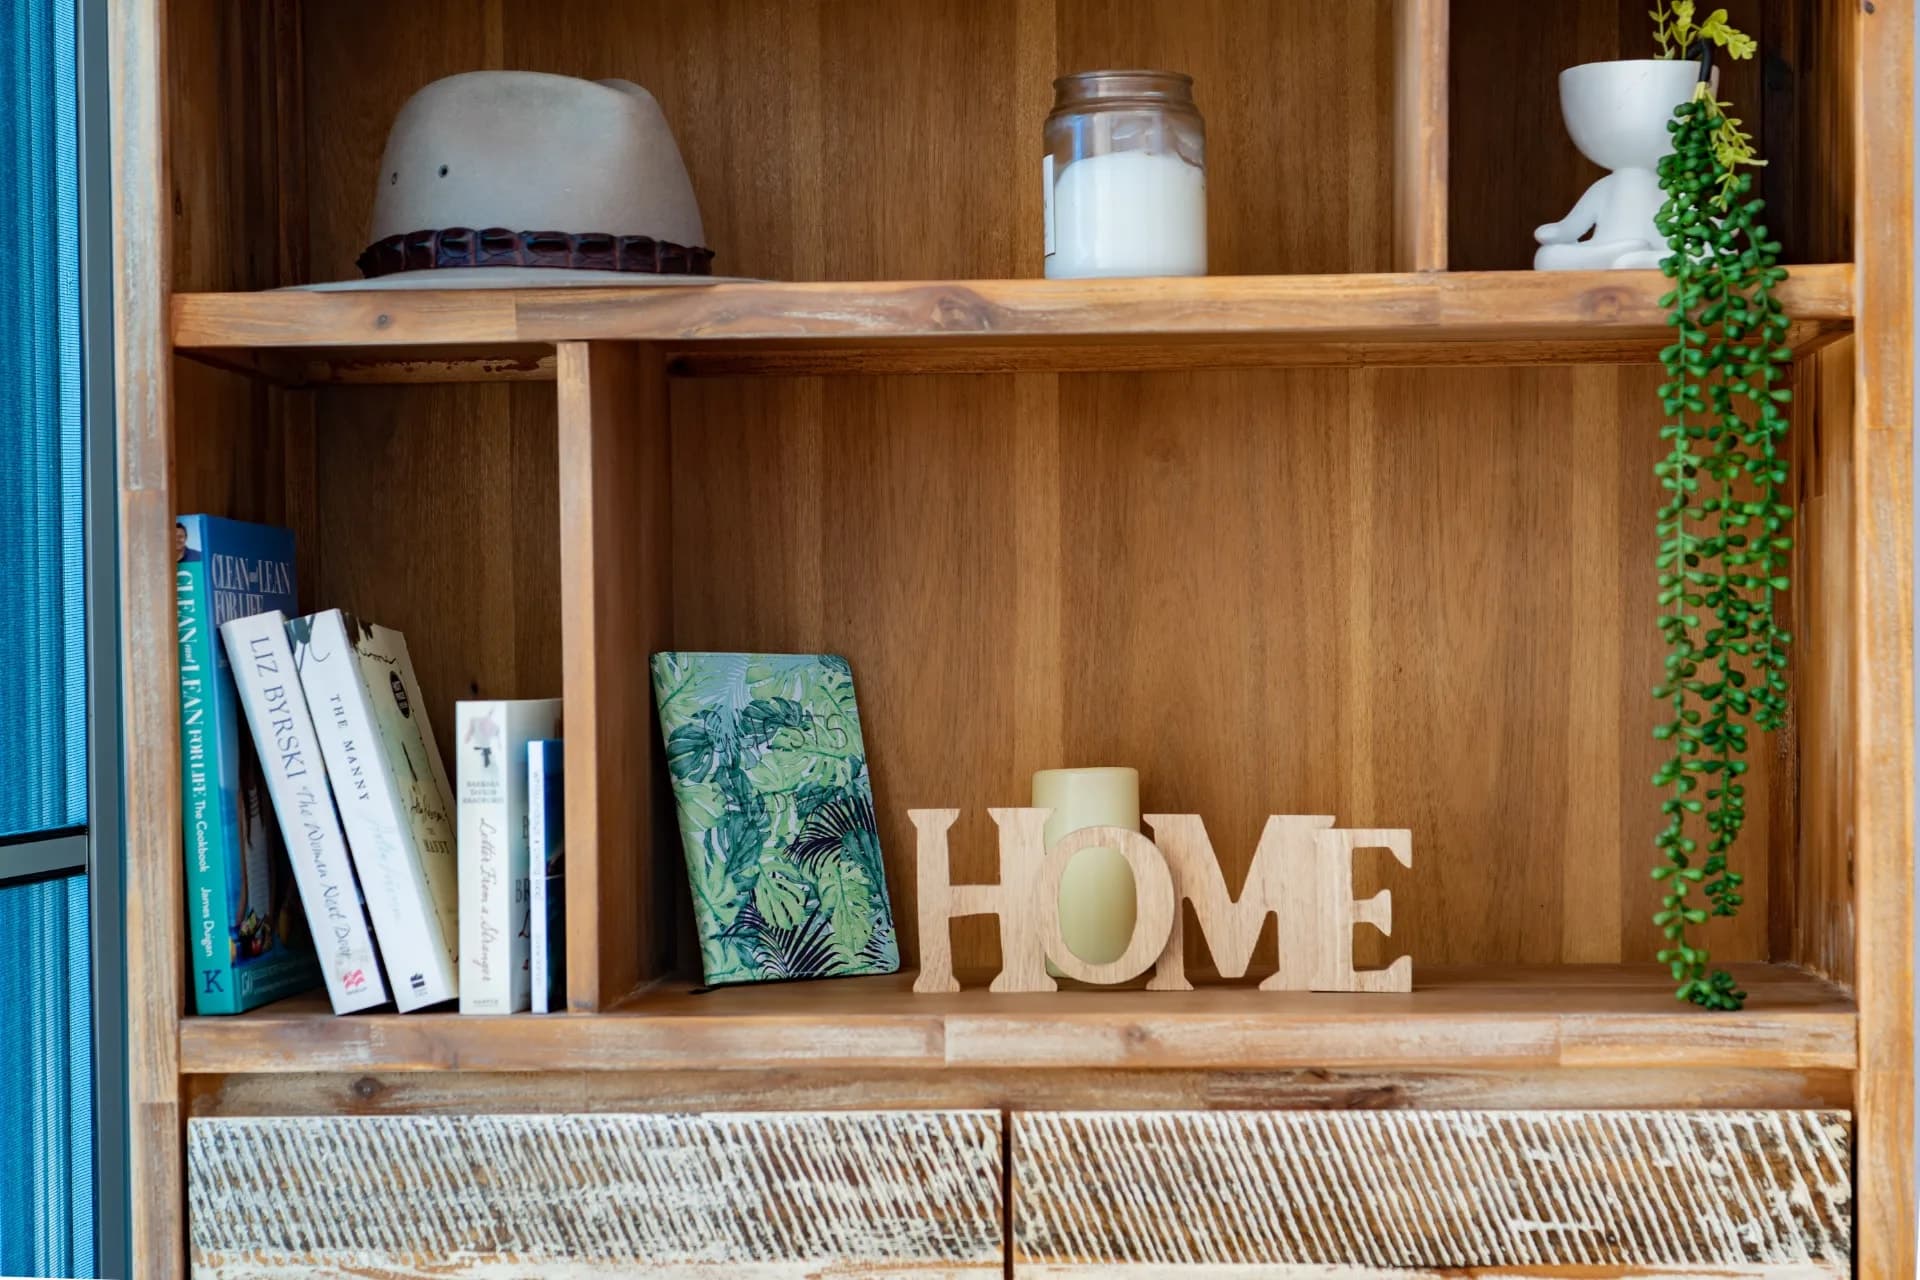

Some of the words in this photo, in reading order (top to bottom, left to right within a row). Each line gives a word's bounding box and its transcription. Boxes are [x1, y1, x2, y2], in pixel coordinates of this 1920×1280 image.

[212, 553, 249, 591] CLEAN
[258, 559, 291, 594] LEAN
[176, 570, 197, 643] CLEAN
[214, 590, 239, 625] FOR
[181, 664, 204, 725] LEAN
[250, 636, 278, 678] LIZ
[264, 685, 307, 779] BYRSKI
[188, 729, 203, 760] FOR
[330, 693, 348, 729] THE
[343, 739, 371, 802] MANNY
[190, 763, 207, 797] LIFE
[194, 799, 206, 819] The
[295, 785, 316, 817] The
[195, 820, 211, 872] Cookbook
[303, 822, 329, 879] Woman
[480, 817, 497, 863] Letter
[200, 886, 212, 919] James
[480, 863, 497, 902] From
[907, 808, 1412, 992] HOME
[201, 920, 215, 957] Duigan
[472, 915, 499, 982] Stranger
[202, 968, 224, 993] K
